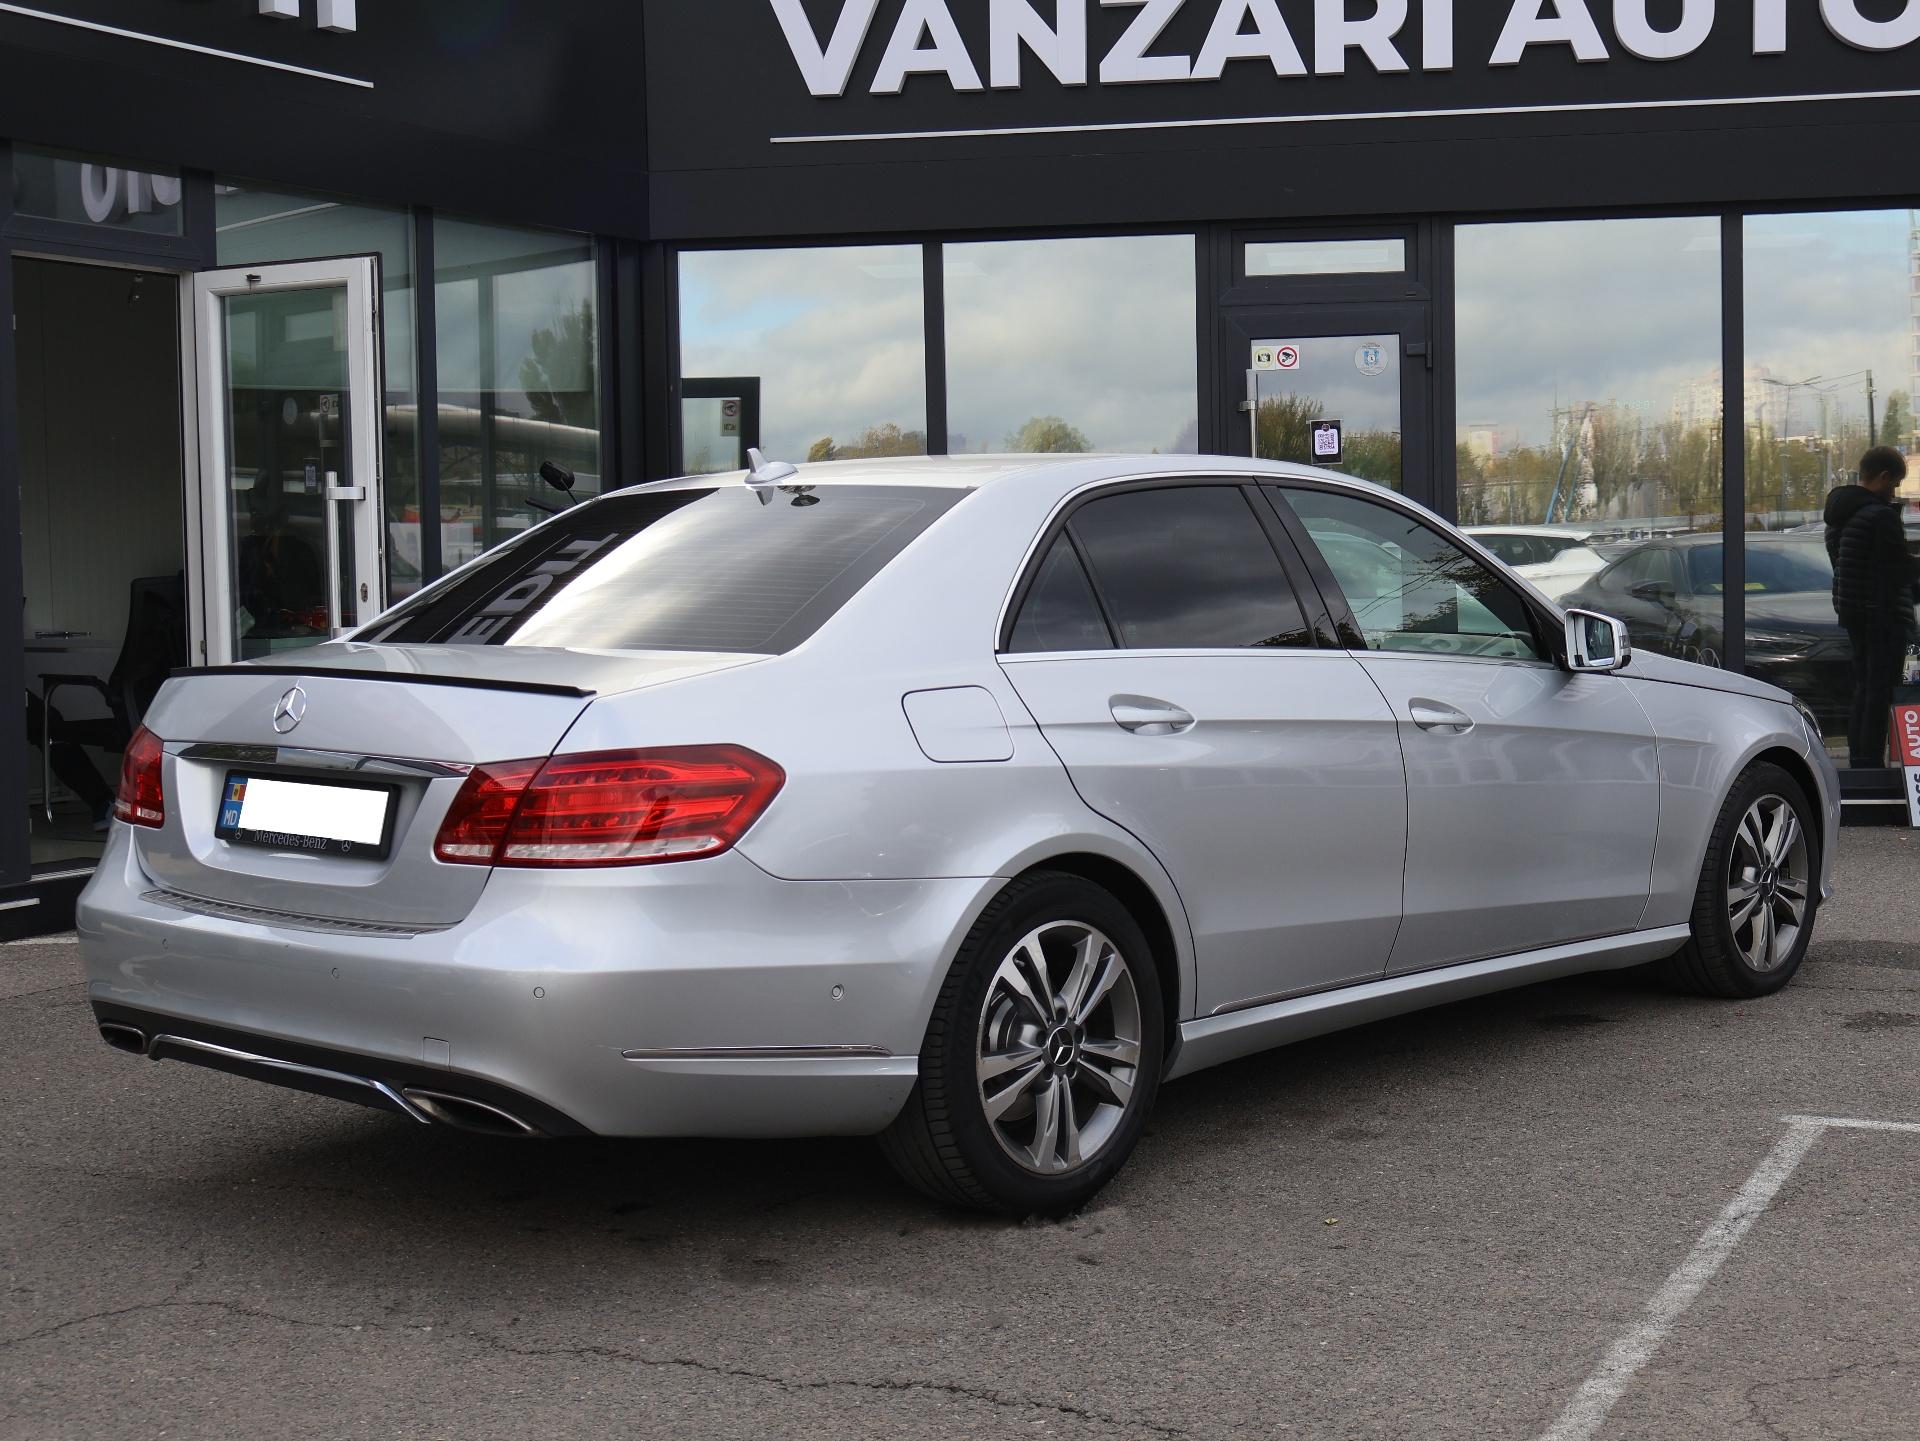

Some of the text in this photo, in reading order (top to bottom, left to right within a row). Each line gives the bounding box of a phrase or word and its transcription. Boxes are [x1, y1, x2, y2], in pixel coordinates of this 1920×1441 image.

[769, 0, 1453, 97] VANZARI
[223, 809, 238, 826] MD
[254, 829, 327, 850] Mercedes-Benz
